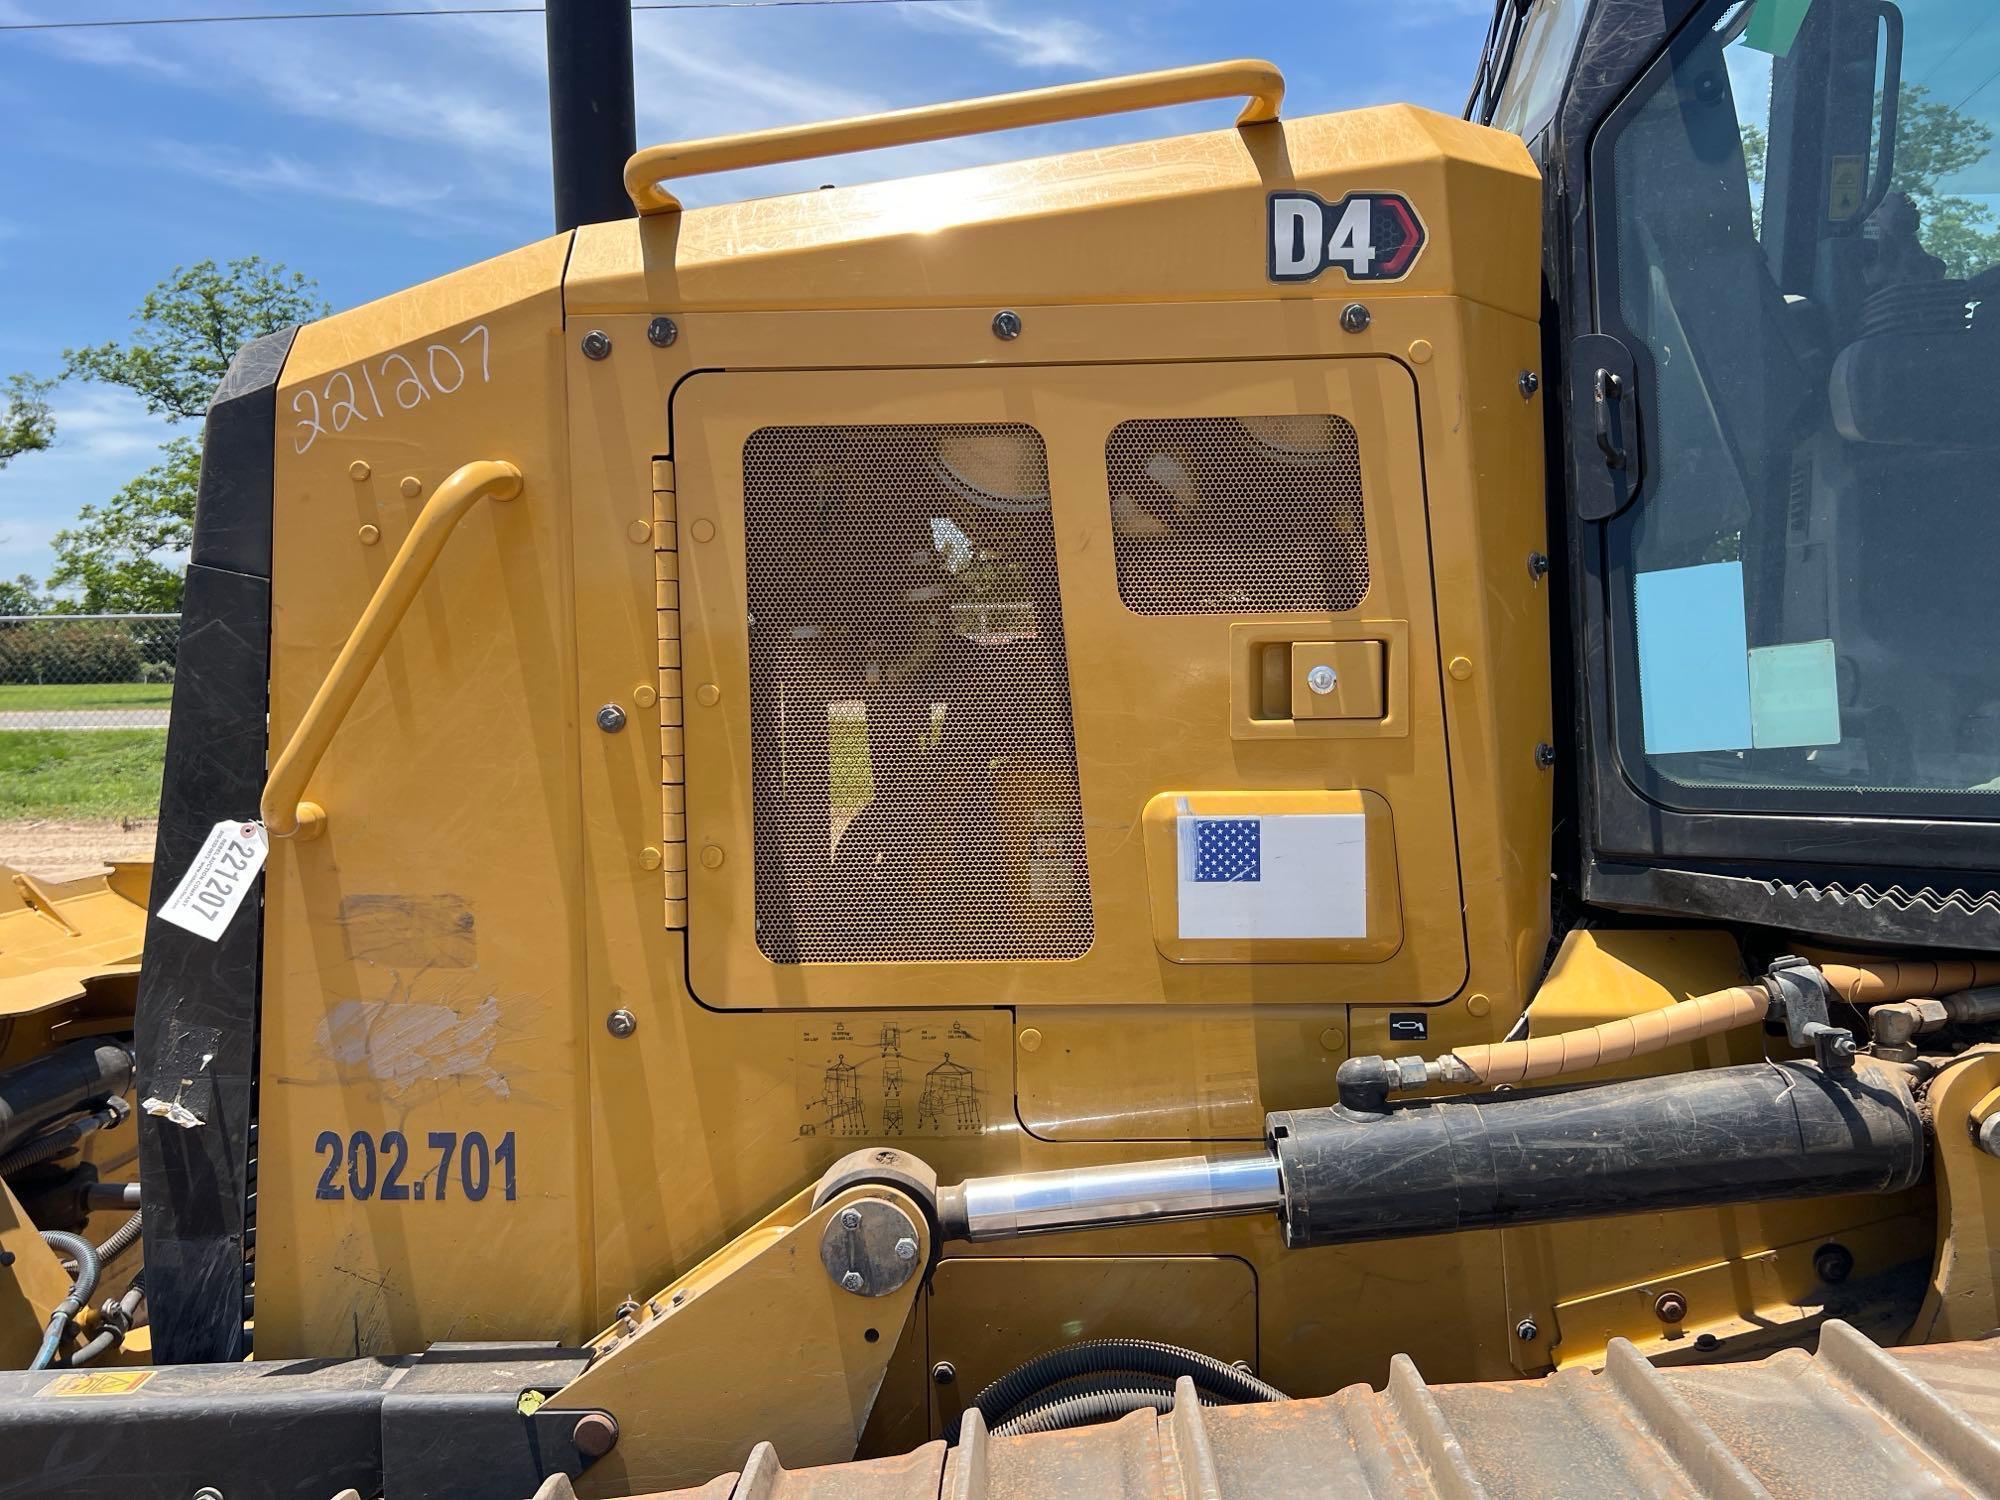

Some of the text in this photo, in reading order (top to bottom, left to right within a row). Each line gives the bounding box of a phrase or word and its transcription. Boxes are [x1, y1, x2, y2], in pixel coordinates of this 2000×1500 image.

[1274, 198, 1377, 276] D4
[292, 324, 490, 455] 221207
[182, 838, 227, 907] REBEL AUCTION COMPANY
[192, 840, 255, 921] 221207
[314, 1130, 517, 1202] 202.701
